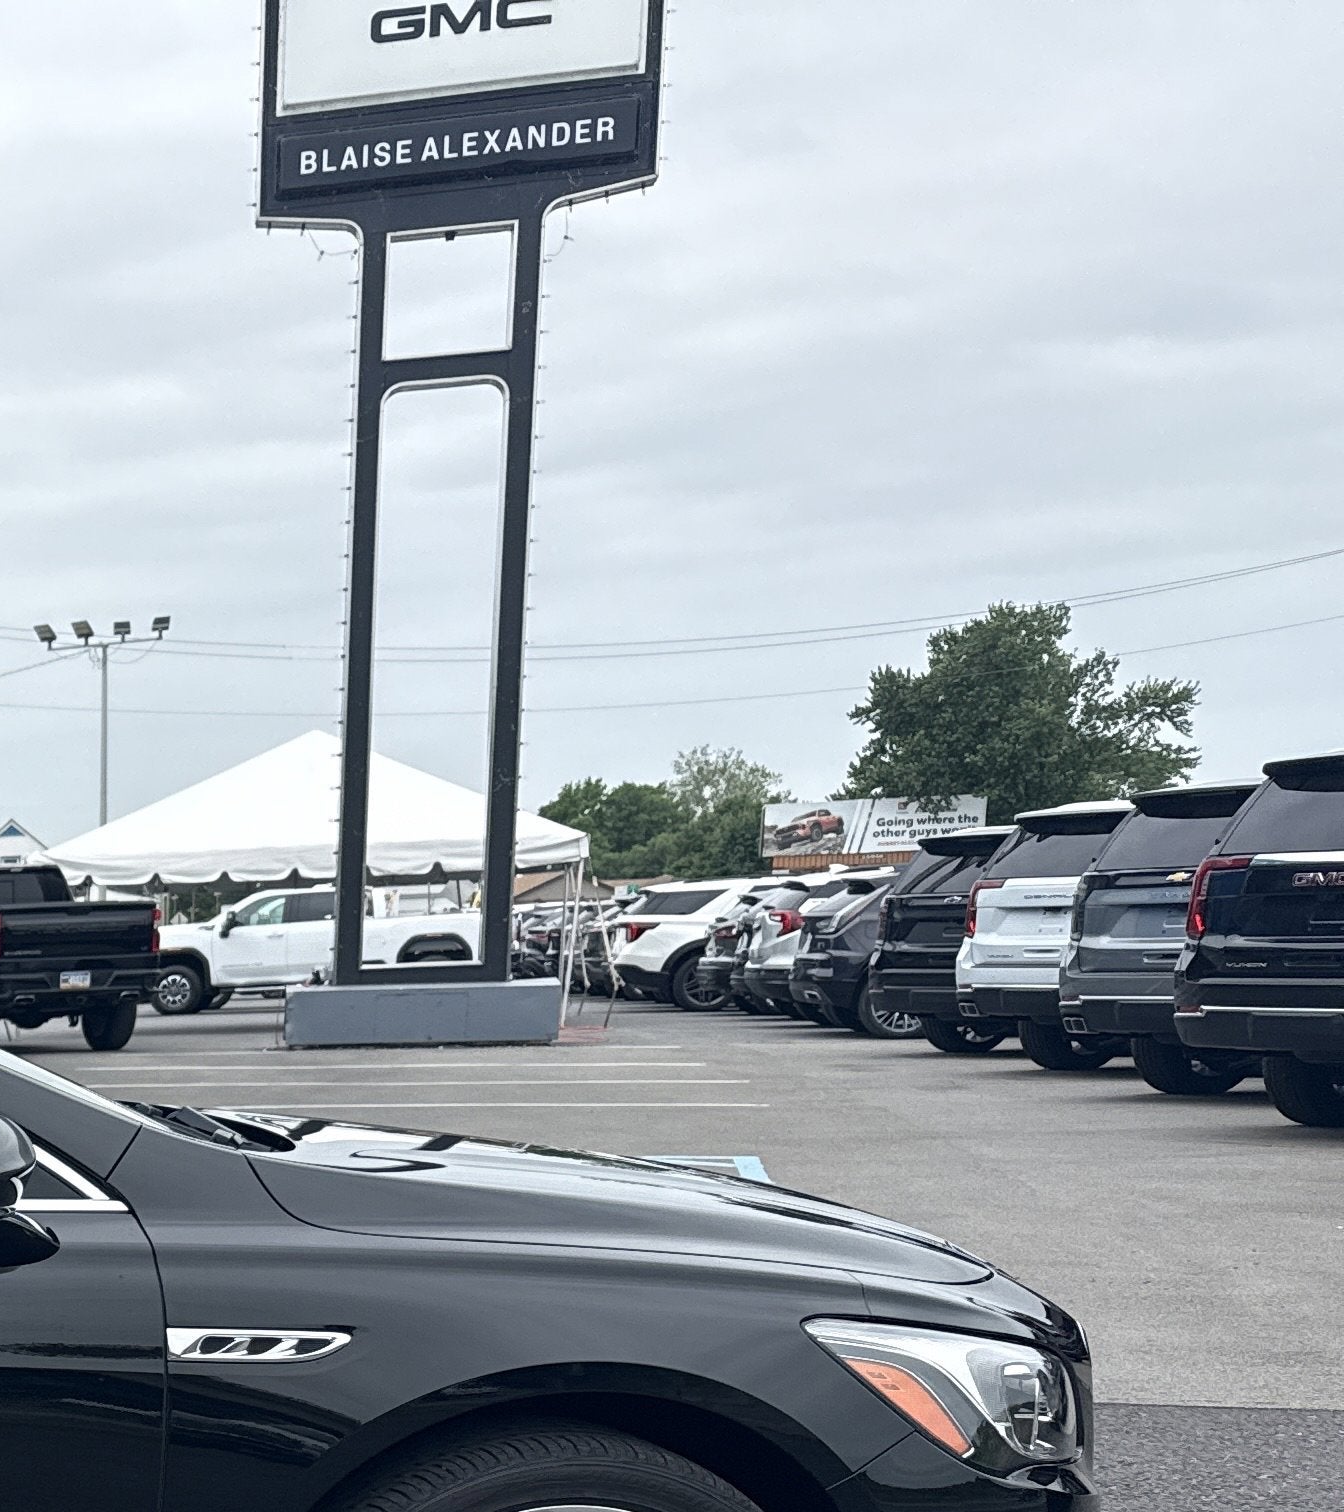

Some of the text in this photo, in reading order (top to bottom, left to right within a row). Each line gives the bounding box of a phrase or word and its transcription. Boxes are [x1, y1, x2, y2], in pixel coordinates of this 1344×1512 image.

[371, 0, 552, 43] GMC
[300, 116, 615, 176] BLAISE ALEXANDER
[872, 828, 907, 838] other
[908, 828, 938, 839] guys
[876, 813, 979, 828] Going where the
